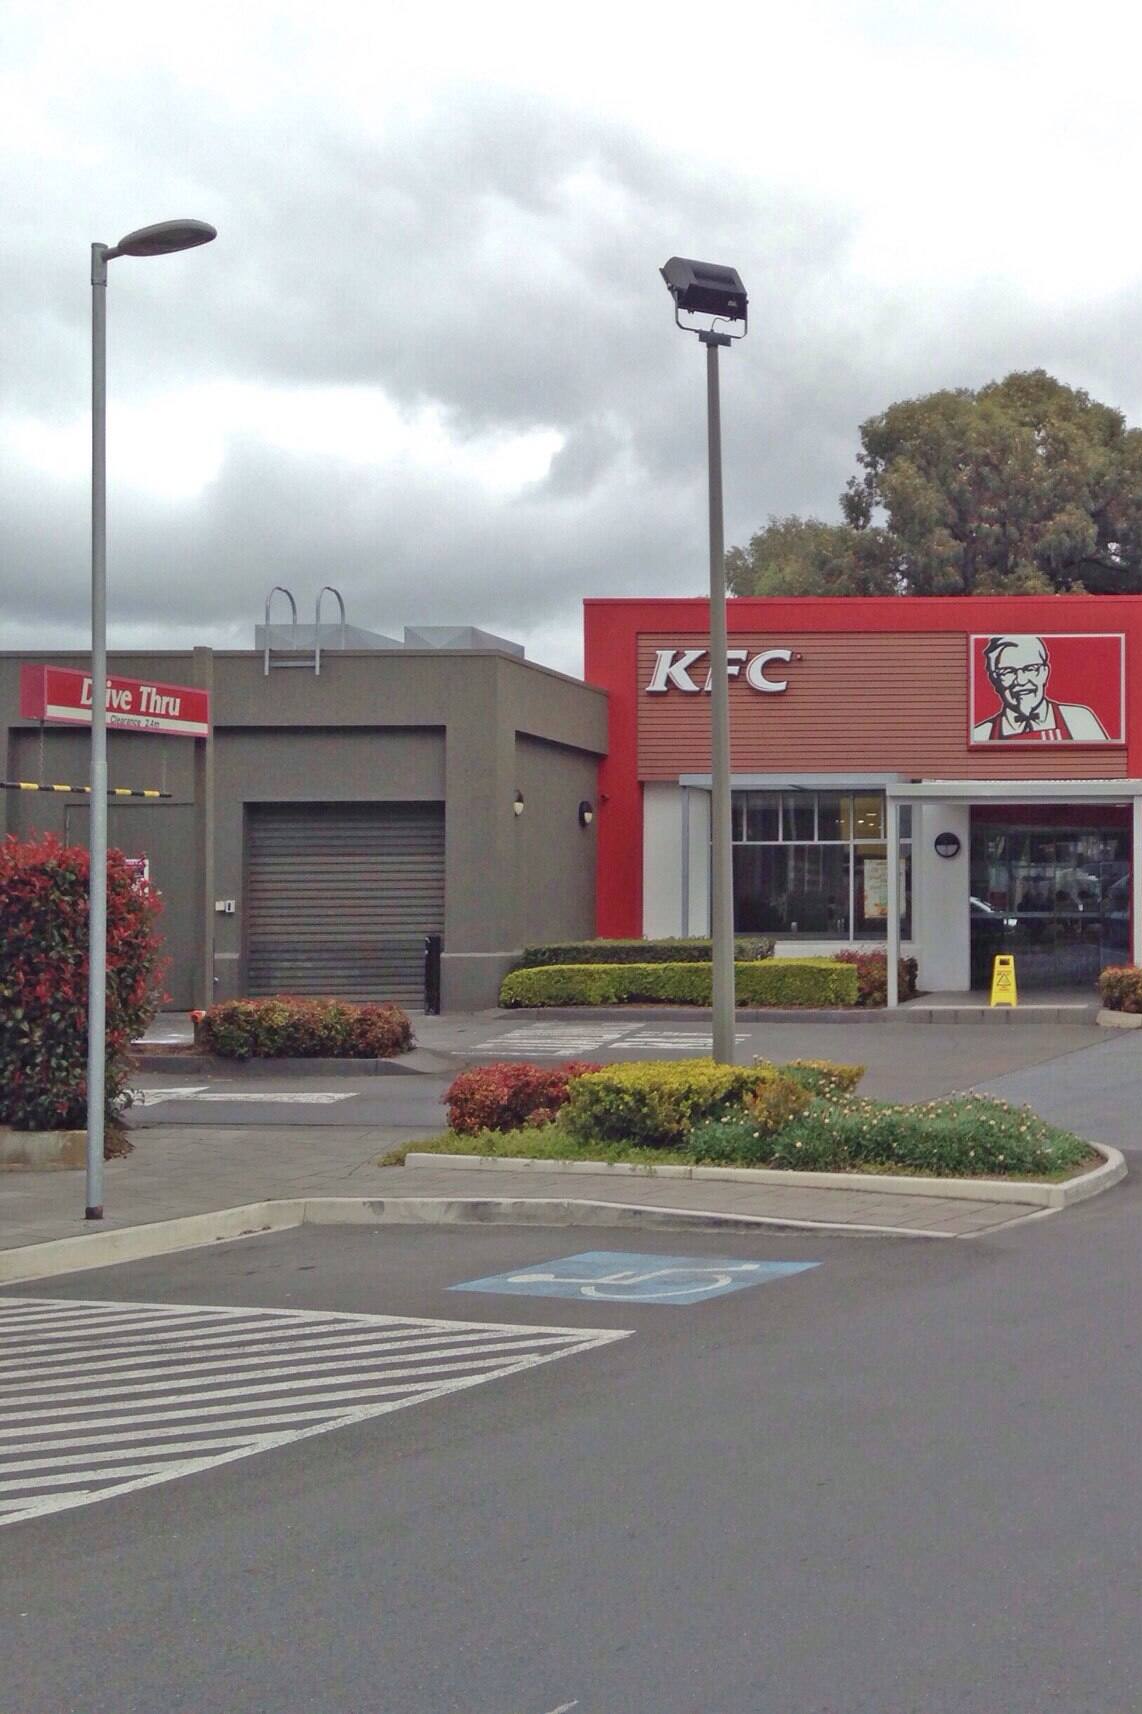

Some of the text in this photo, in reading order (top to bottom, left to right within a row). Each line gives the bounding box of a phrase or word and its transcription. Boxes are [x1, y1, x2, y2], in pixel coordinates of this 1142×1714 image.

[645, 649, 793, 693] KFC
[80, 677, 181, 716] Dive Thru
[110, 715, 142, 726] Clearance
